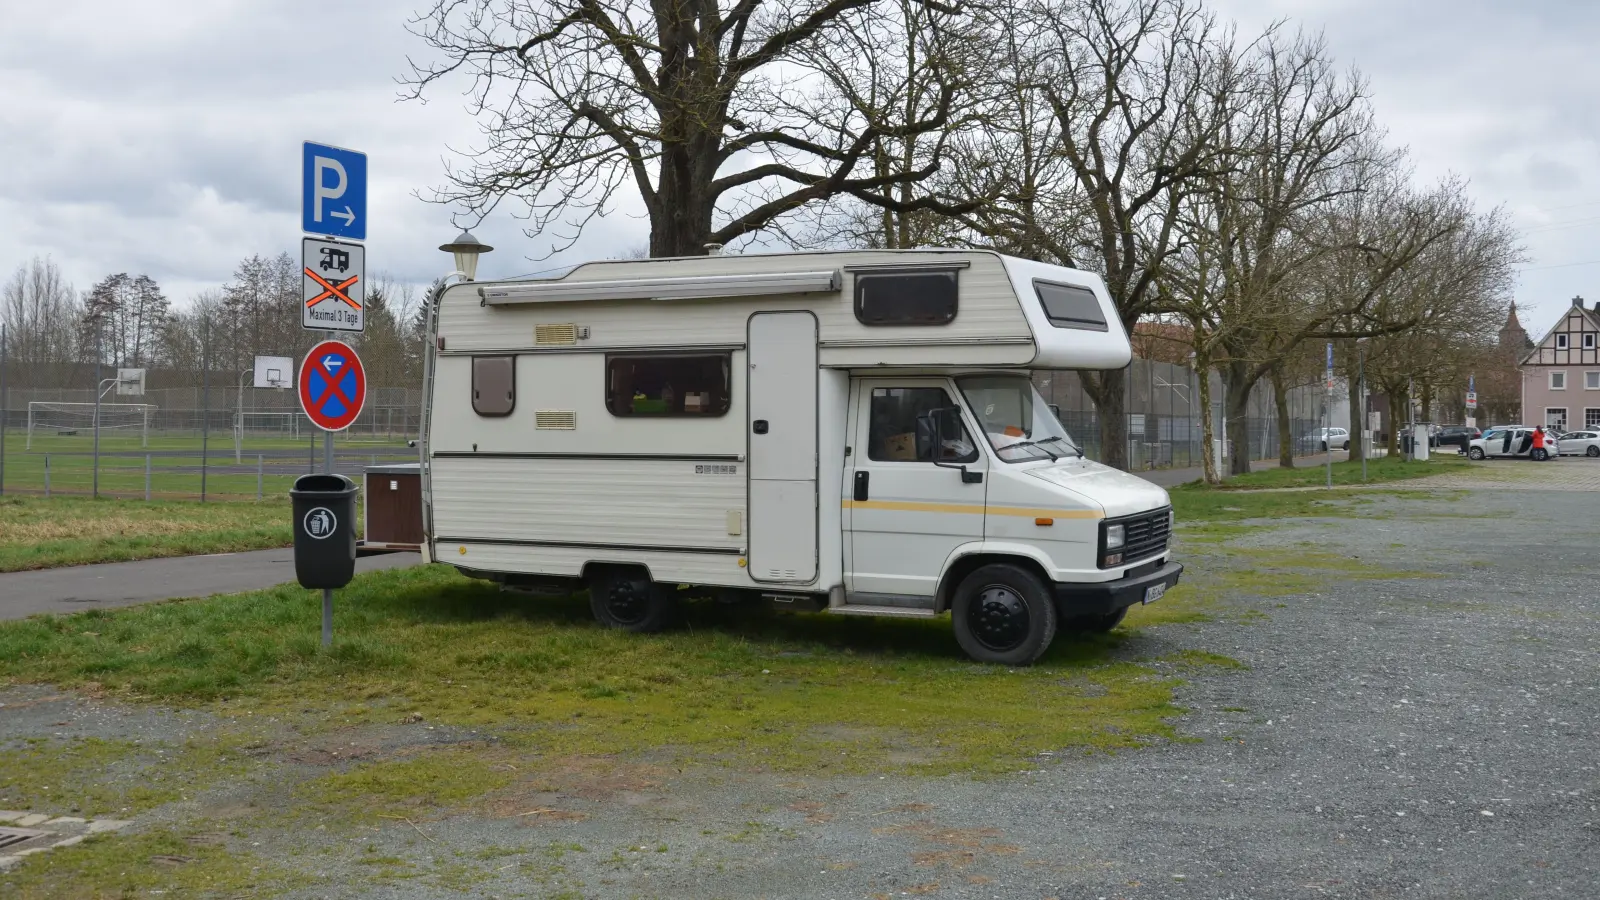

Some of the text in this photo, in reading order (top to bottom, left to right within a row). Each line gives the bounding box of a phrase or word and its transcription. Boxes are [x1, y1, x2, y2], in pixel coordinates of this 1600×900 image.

[313, 155, 348, 222] P
[309, 308, 358, 326] Maximal 3 Tage
